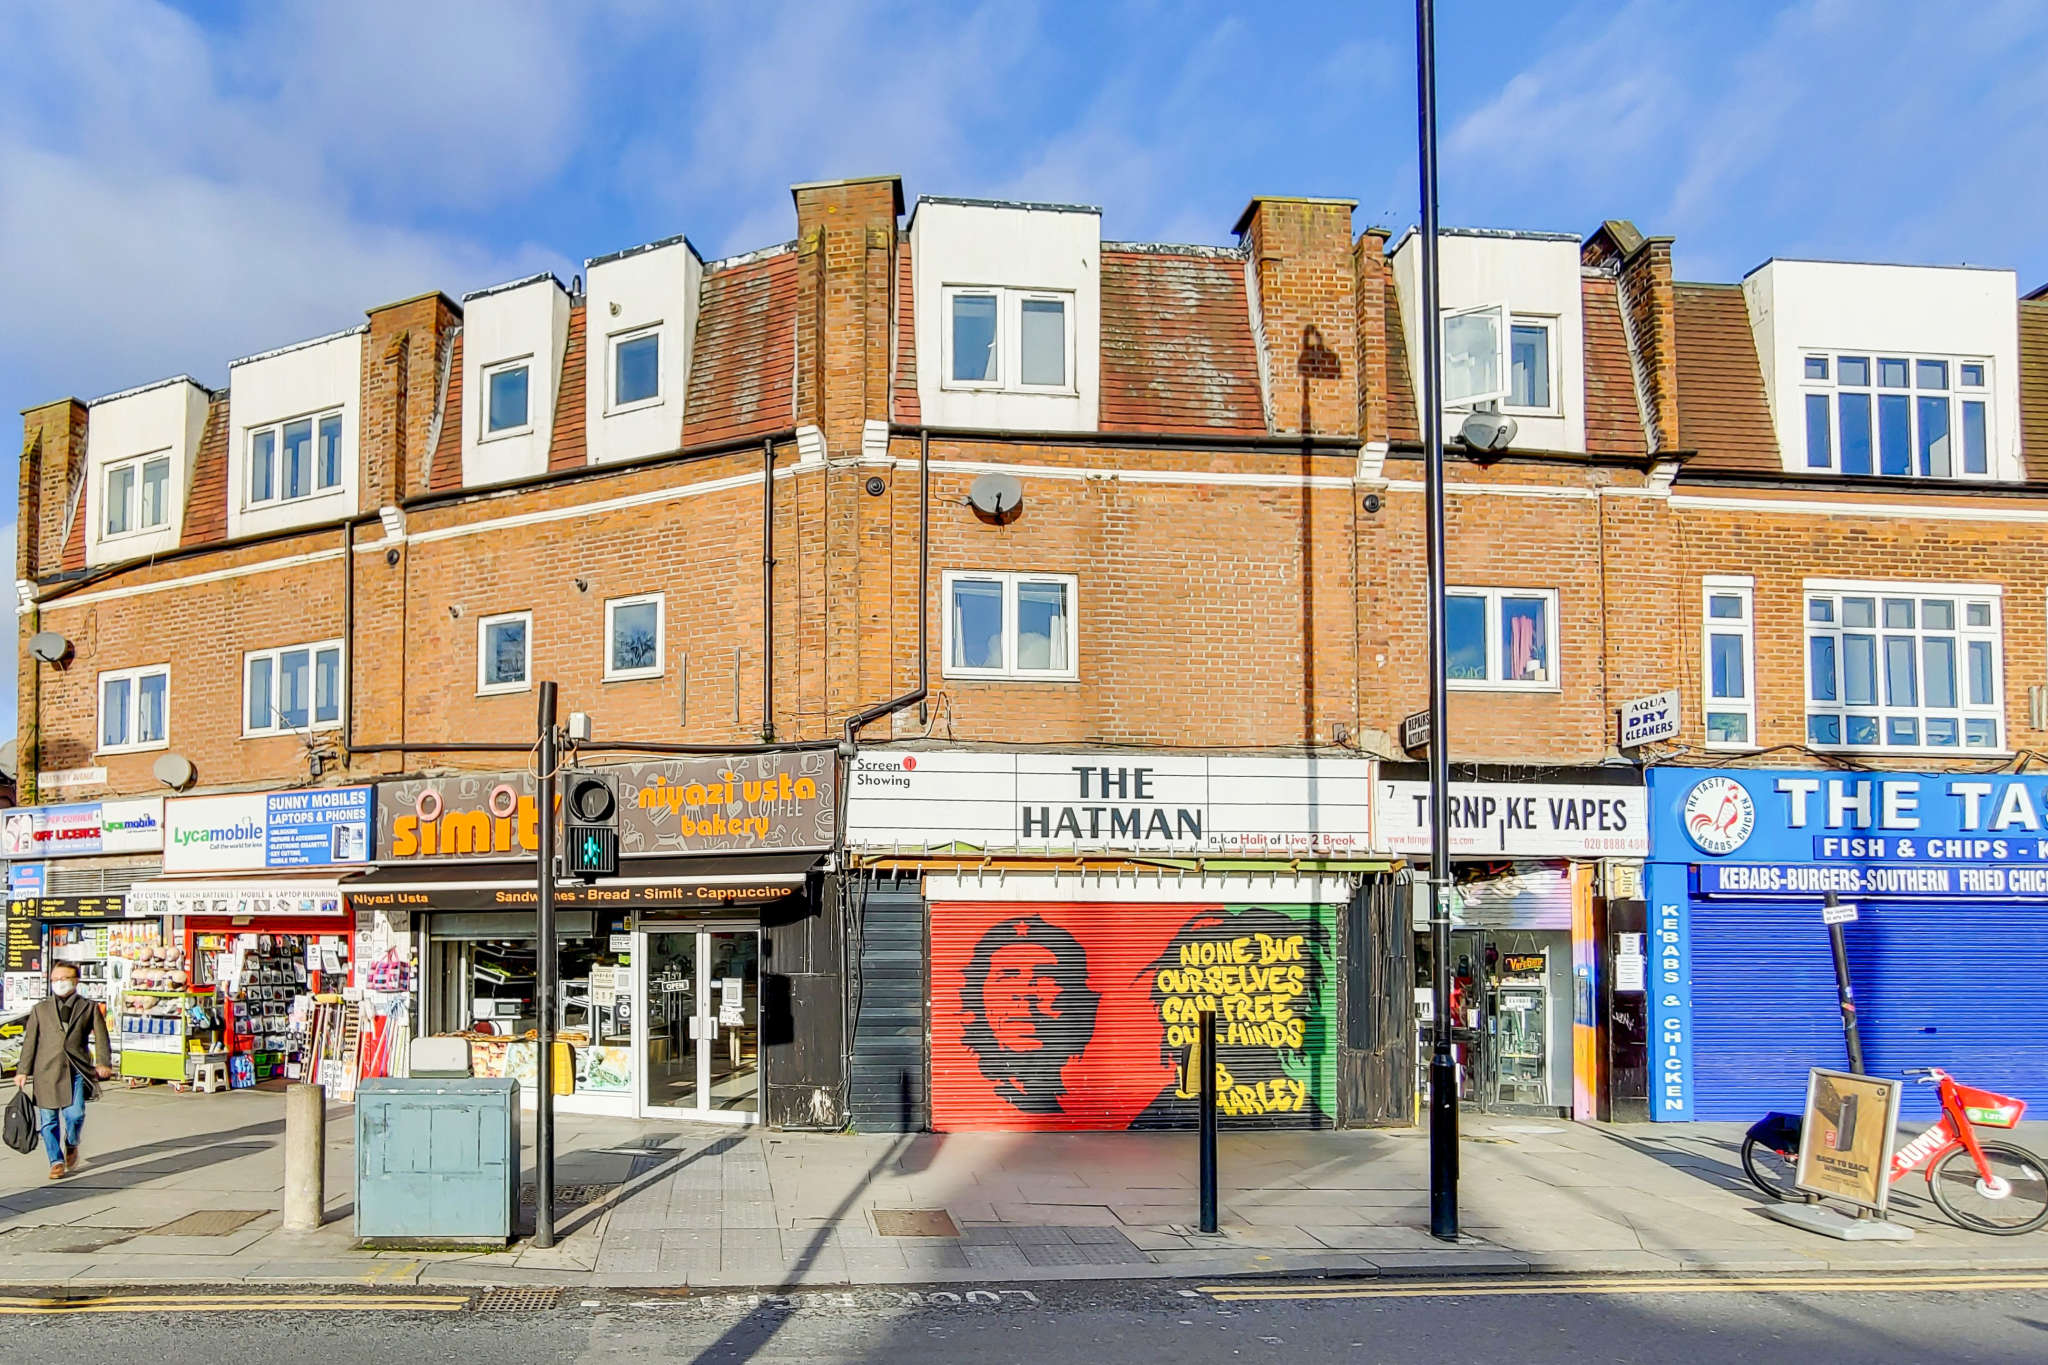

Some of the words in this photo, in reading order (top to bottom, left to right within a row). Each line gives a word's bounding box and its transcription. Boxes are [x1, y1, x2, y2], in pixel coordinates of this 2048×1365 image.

[1631, 697, 1667, 712] AQUA
[1629, 709, 1669, 727] DRY
[1626, 721, 1673, 741] CLEANERS
[857, 758, 901, 771] Screen
[857, 774, 911, 788] Showing
[1072, 767, 1154, 799] THE
[269, 794, 309, 810] SUNNY
[312, 791, 366, 807] MOBILES
[638, 771, 734, 815] niyazi
[743, 773, 816, 802] usta
[1387, 785, 1395, 799] 7
[1687, 795, 1699, 813] THE
[1697, 778, 1726, 794] TASTY
[1413, 795, 1537, 831] TRNPIKE
[1548, 797, 1627, 832] VAPES
[1777, 779, 1920, 829] THE
[1951, 782, 2048, 830] TA
[102, 817, 156, 832] Lycamobile
[269, 811, 314, 825] LAPTOPS
[315, 811, 323, 822] &
[325, 808, 366, 821] PHONES
[393, 784, 562, 856] simit
[681, 814, 769, 840] bakery
[1023, 806, 1201, 840] HATMAN
[1697, 833, 1733, 851] KEBABS
[1736, 796, 1753, 841] CHICKEN
[33, 830, 54, 841] OFF
[56, 827, 101, 840] LICENCE
[174, 822, 263, 846] Lycamobile
[1210, 834, 1237, 845] a.k.a
[1240, 833, 1267, 845] Halit
[1270, 834, 1281, 845] of
[1285, 834, 1307, 845] Live
[1311, 834, 1319, 845] 2
[1323, 834, 1356, 846] Break
[1584, 838, 1600, 849] 020
[1823, 838, 1885, 857] FISH
[1896, 839, 1916, 858] &
[1927, 839, 2008, 859] CHIPS
[1959, 869, 2004, 891] FRIED
[2008, 870, 2048, 892] CHIC
[303, 890, 338, 898] REPAIRING
[353, 893, 394, 905] Niyazi
[398, 893, 429, 903] Usta
[587, 888, 630, 900] Bread
[644, 887, 682, 899] Simit
[696, 886, 791, 901] Cappuccino
[1180, 937, 1254, 966] NONE
[1254, 933, 1303, 965] BUT
[1661, 905, 1680, 983] KEBABS
[666, 982, 684, 990] OPEN
[1157, 965, 1304, 996] OURSELVES
[1222, 993, 1293, 1023] FREE
[1662, 995, 1681, 1007] &
[1167, 1025, 1224, 1047] OU
[1663, 1018, 1684, 1110] CHICKEN
[1896, 1125, 1946, 1168] JUMP
[1848, 1161, 1870, 1172] BACK
